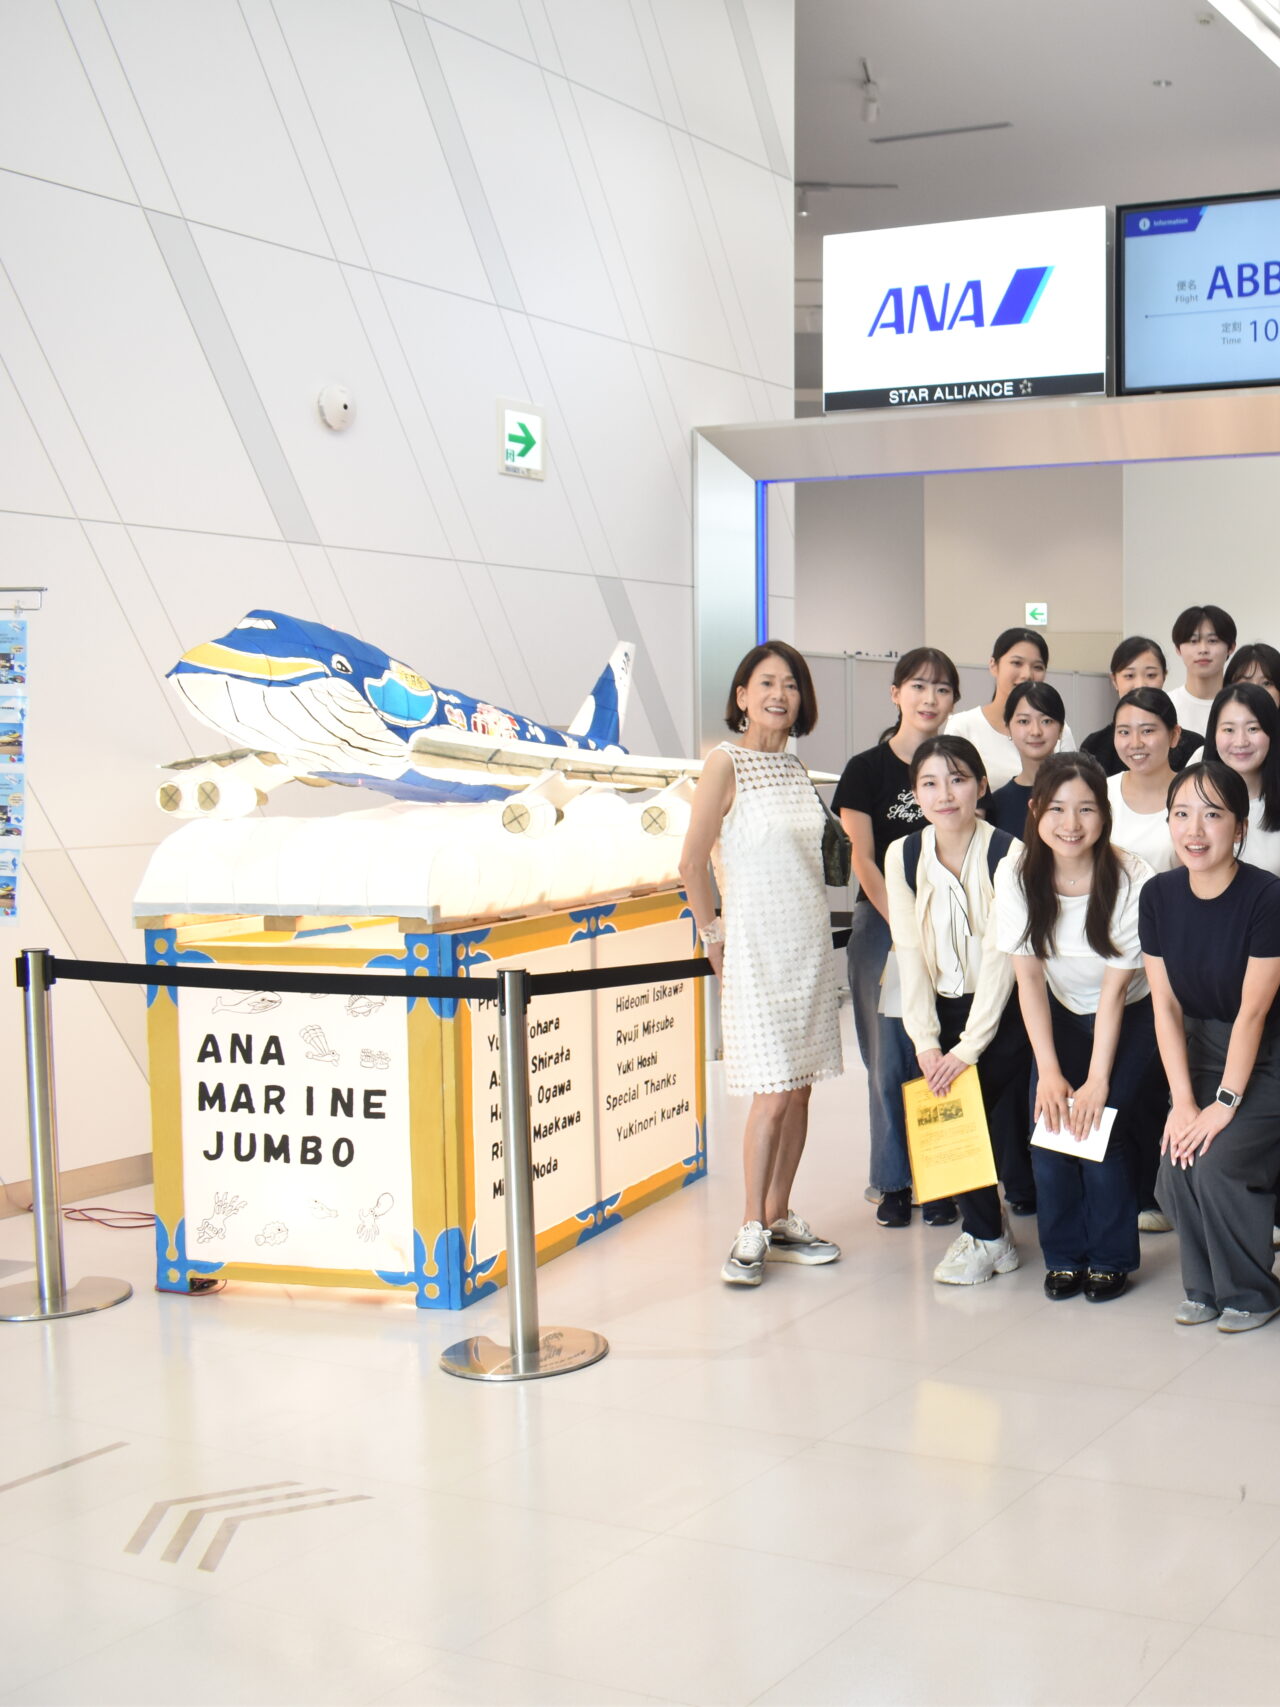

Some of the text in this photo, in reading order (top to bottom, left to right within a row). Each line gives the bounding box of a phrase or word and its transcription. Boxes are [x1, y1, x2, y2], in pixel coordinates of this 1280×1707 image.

[867, 279, 985, 337] ANA
[1175, 294, 1199, 304] Flight
[1221, 336, 1242, 345] Time
[889, 382, 1014, 404] STAR ALLIANCE
[616, 989, 650, 1013] Hideomi
[527, 1016, 560, 1039] ohara
[616, 1024, 639, 1046] Ryuji
[197, 1033, 285, 1065] ANA
[531, 1046, 571, 1074] Shirata
[617, 1051, 658, 1076] Yuki Hoshi
[198, 1081, 387, 1119] MARINE
[537, 1079, 571, 1104] Ogawa
[606, 1083, 639, 1111] Special
[660, 1098, 689, 1122] Kurata
[203, 1131, 354, 1167] JUMBO
[532, 1157, 558, 1181] Noda
